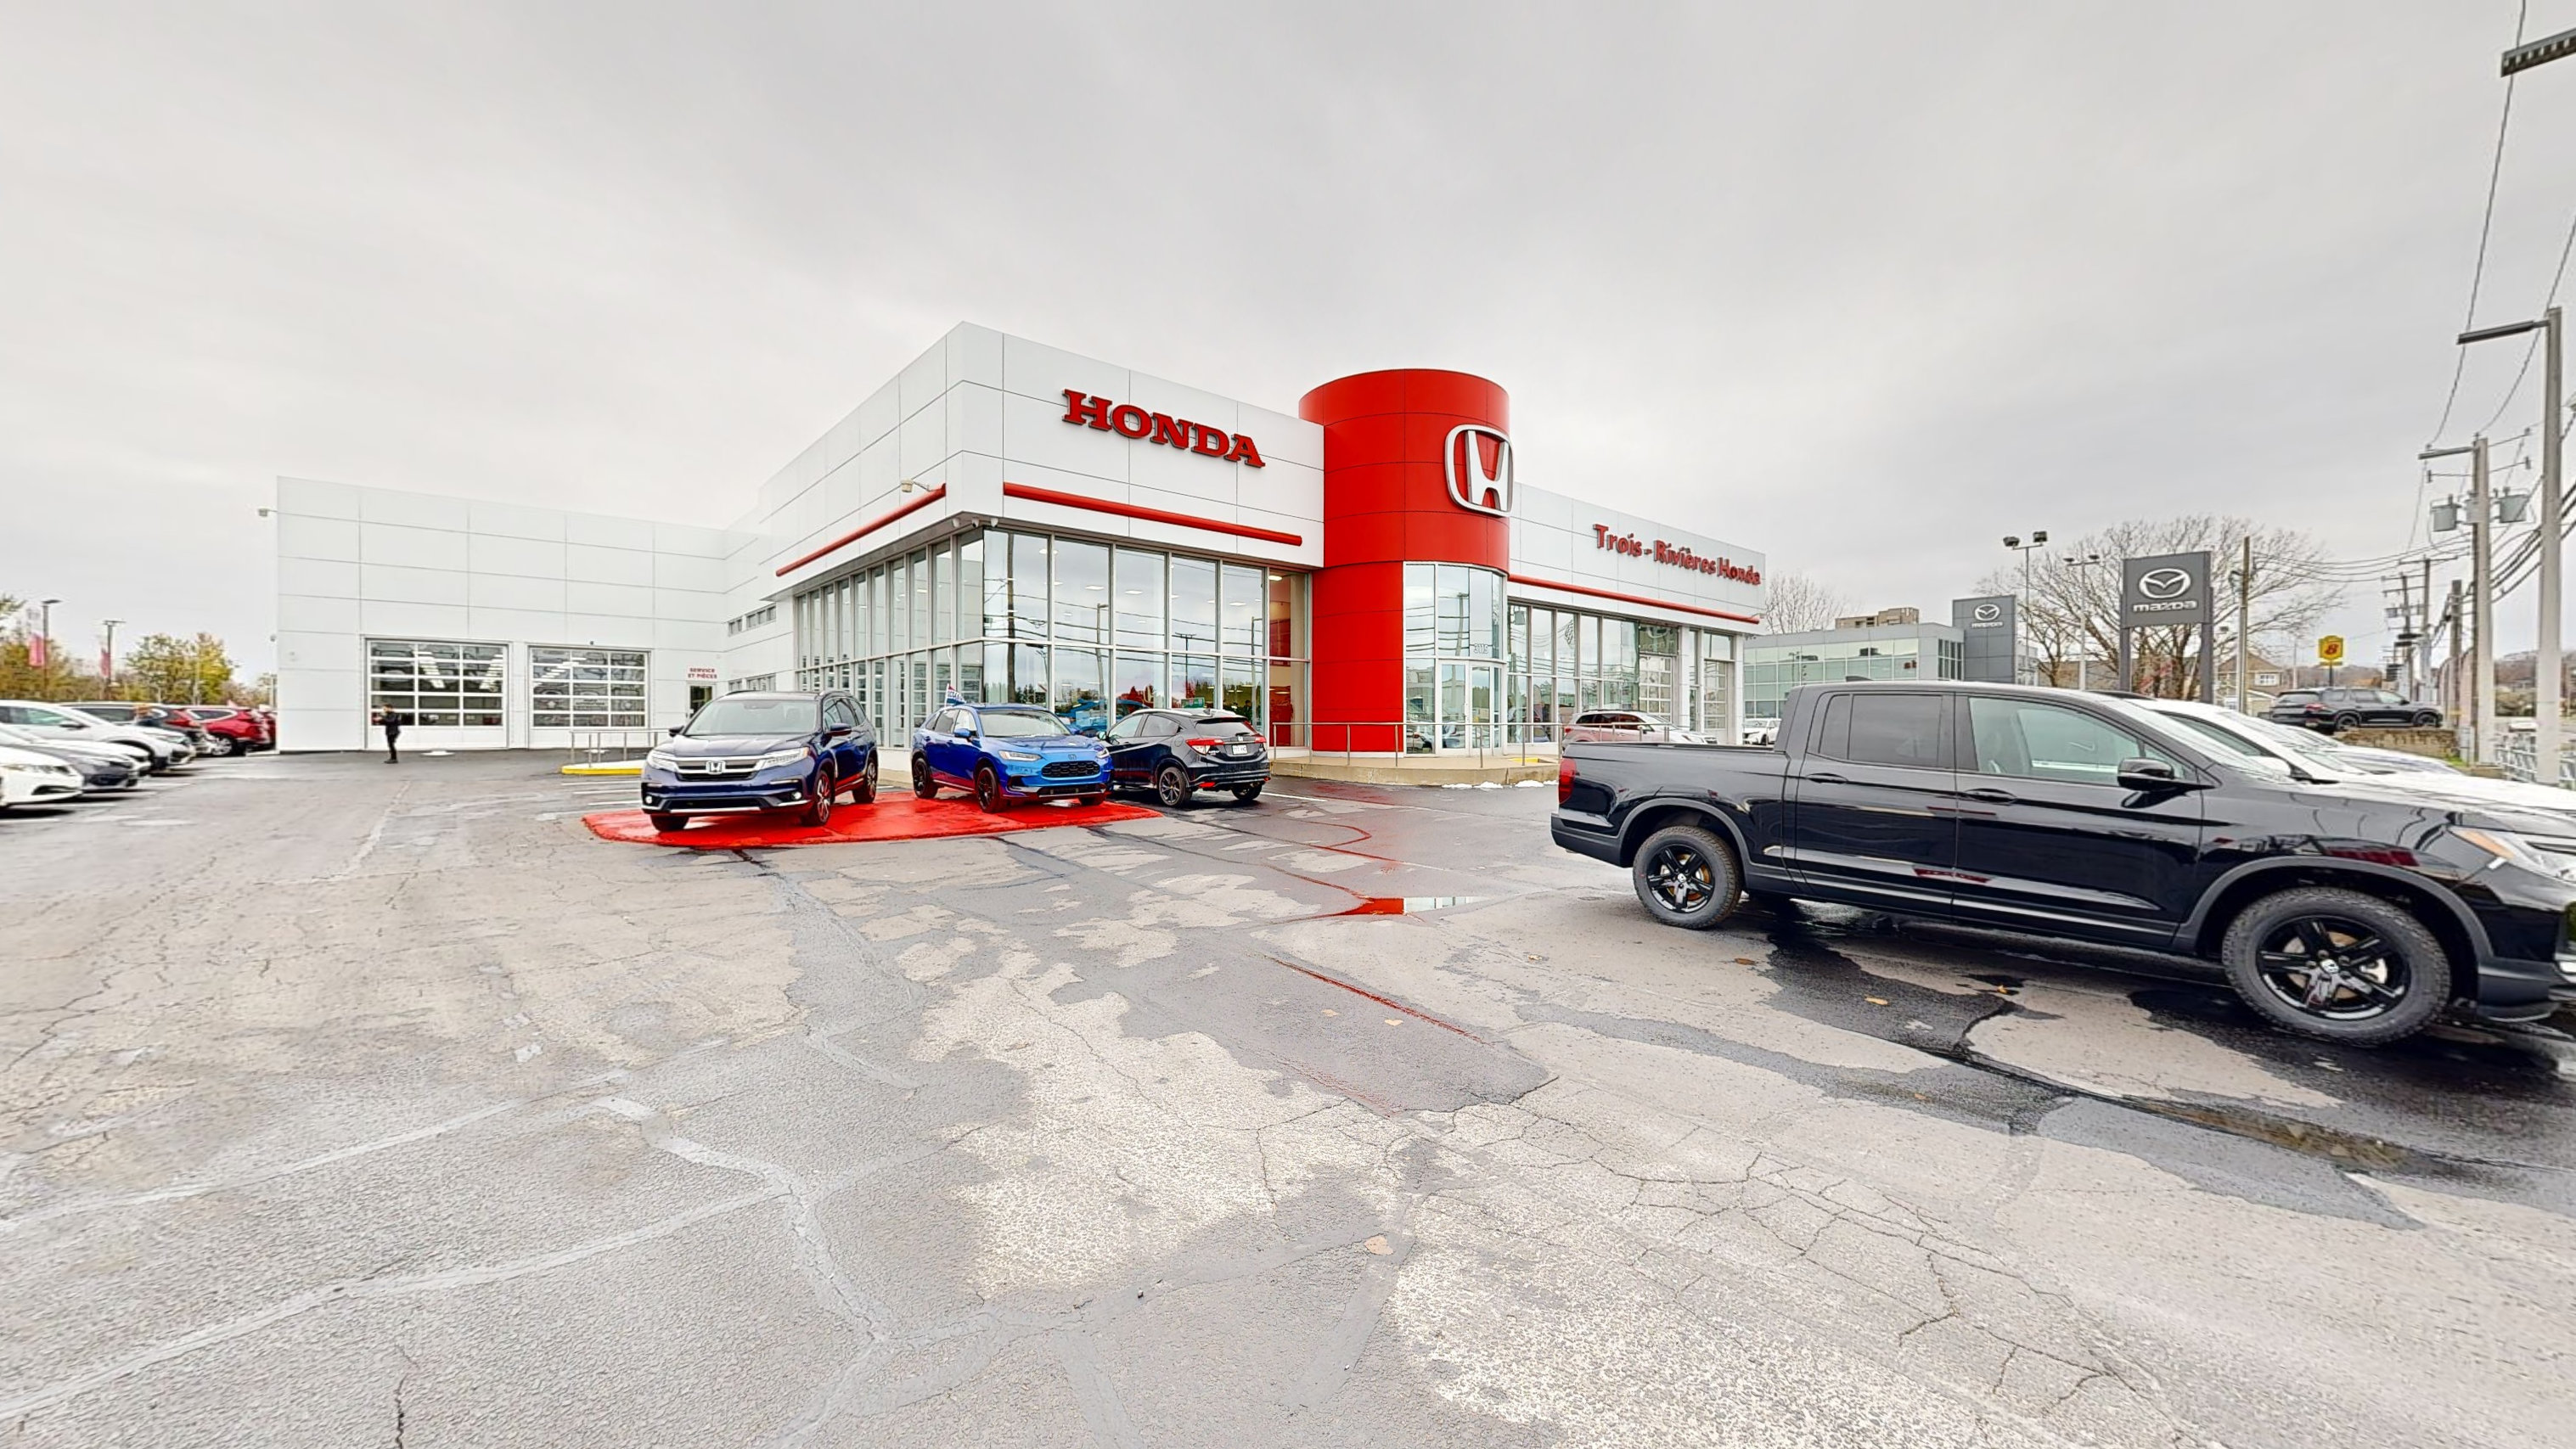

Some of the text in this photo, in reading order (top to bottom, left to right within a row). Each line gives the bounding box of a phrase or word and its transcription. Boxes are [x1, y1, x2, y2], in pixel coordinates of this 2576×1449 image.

[1061, 389, 1266, 468] HONDA
[1717, 557, 1761, 586] Honda
[2133, 600, 2197, 612] mazda
[2324, 643, 2339, 655] 8
